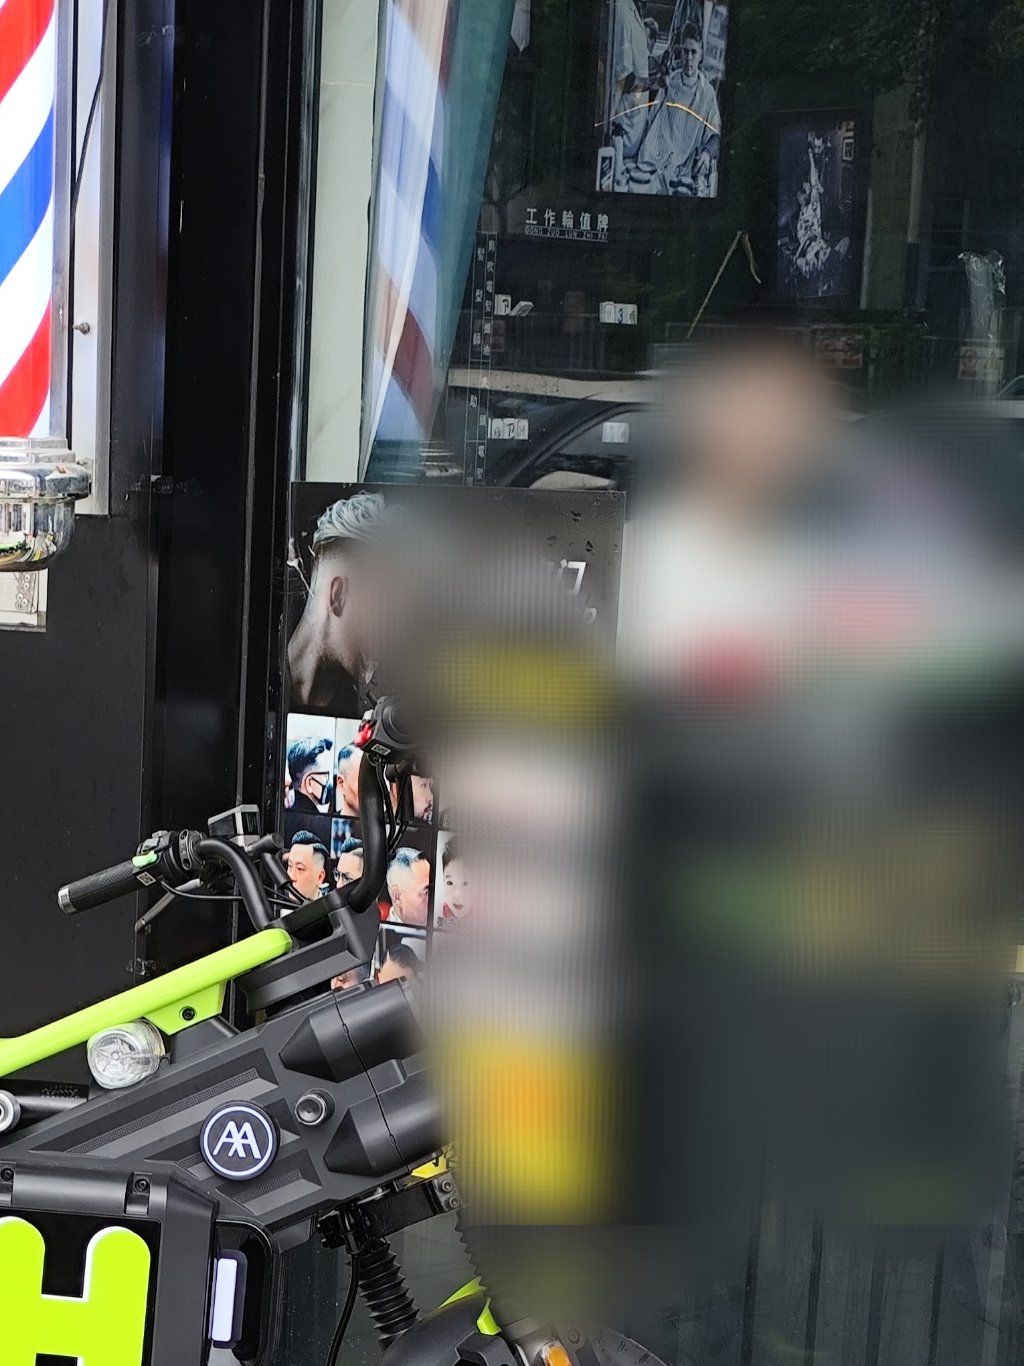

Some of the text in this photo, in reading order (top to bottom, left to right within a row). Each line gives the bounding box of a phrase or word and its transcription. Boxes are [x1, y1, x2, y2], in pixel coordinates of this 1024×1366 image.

[525, 207, 609, 231] 工作輪值牌
